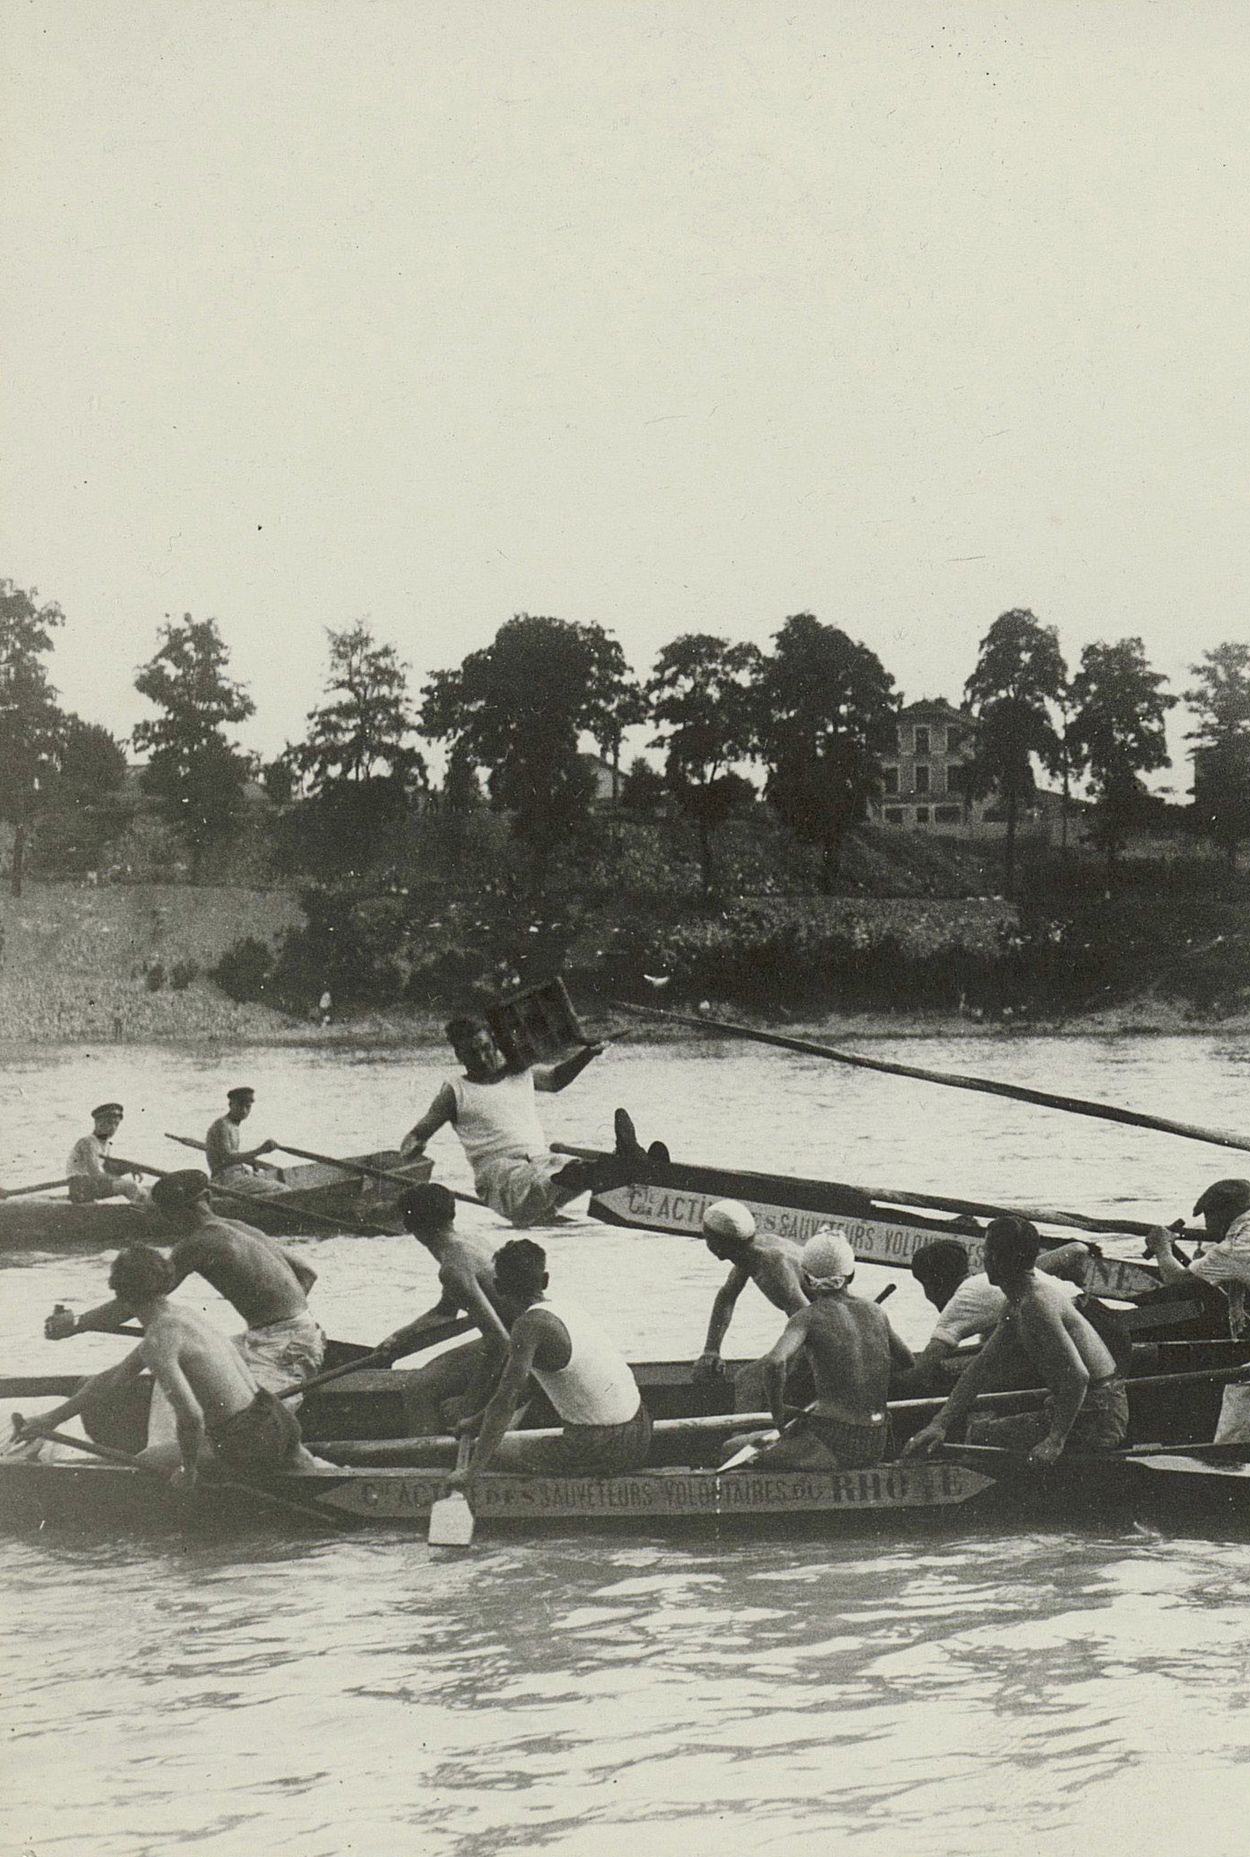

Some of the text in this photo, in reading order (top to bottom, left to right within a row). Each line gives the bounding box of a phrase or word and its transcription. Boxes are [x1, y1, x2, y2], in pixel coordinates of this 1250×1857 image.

[656, 1194, 714, 1223] ACTI
[779, 1213, 875, 1251] SAUVURS
[885, 1228, 986, 1269] VOLOES
[397, 1482, 480, 1509] ACTE
[539, 1480, 656, 1508] SAUVETEURS
[664, 1477, 790, 1507] VOLONTAIRES
